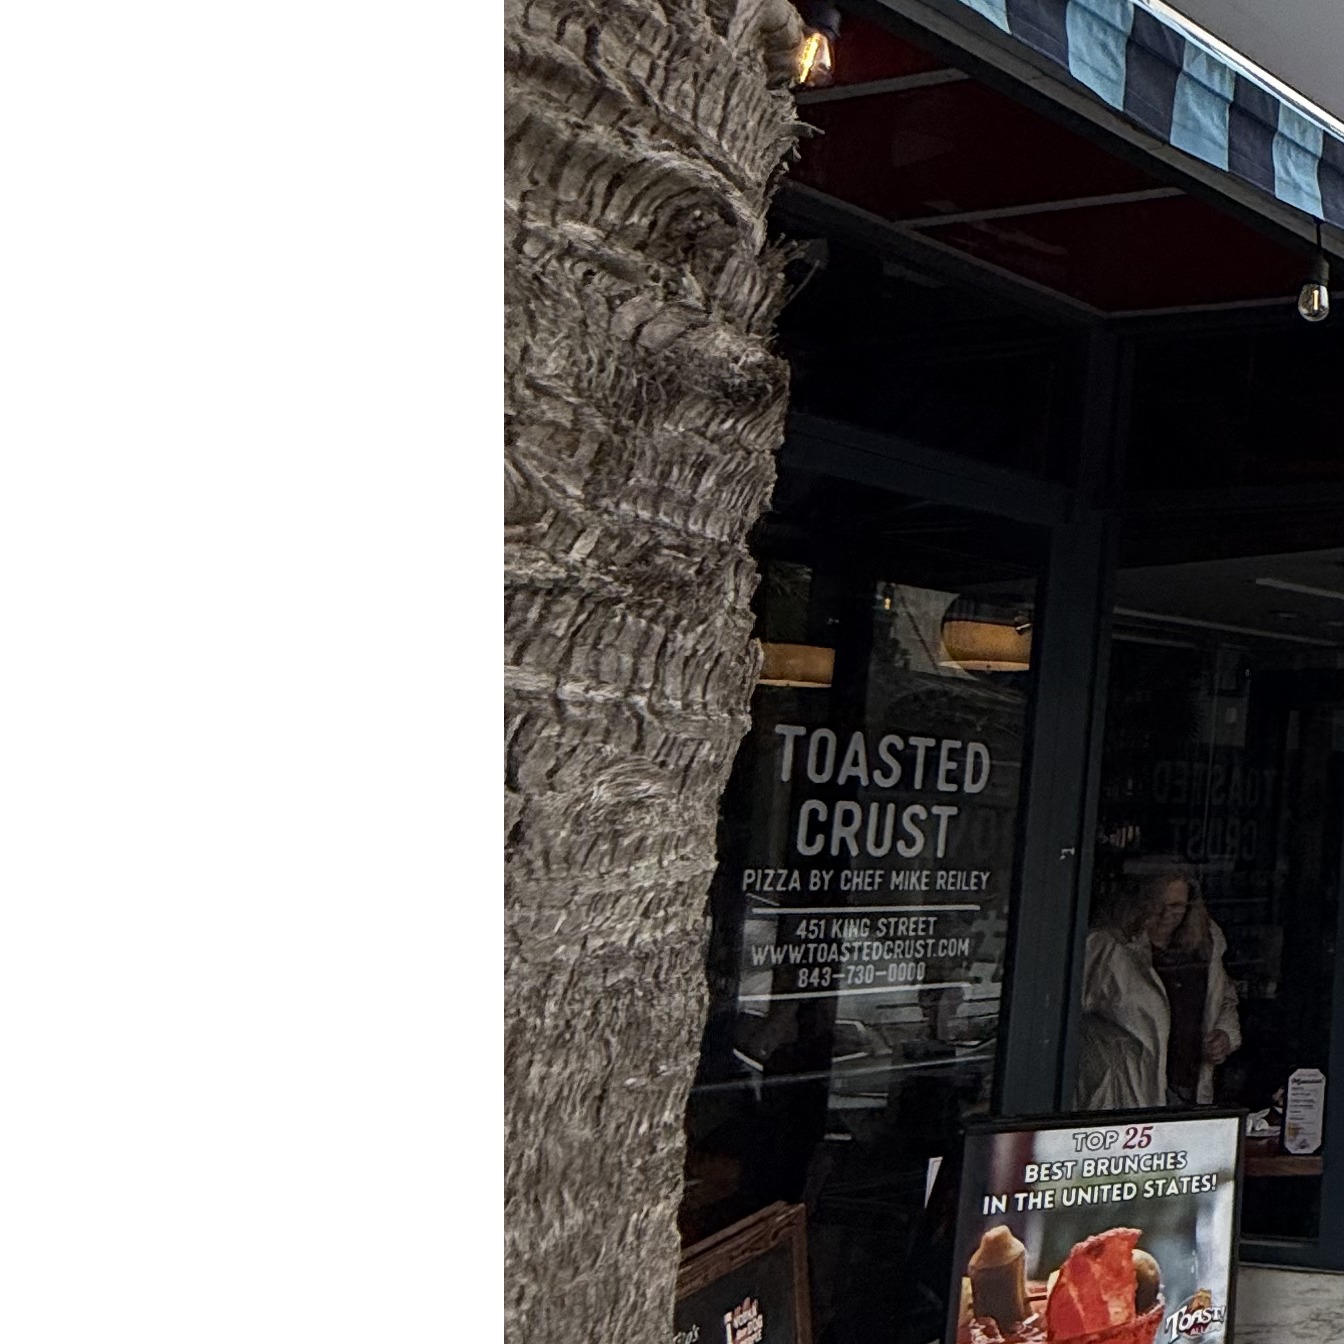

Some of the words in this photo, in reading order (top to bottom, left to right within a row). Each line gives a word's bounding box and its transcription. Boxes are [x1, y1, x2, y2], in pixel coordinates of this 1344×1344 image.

[774, 724, 991, 794] TOASTED
[796, 799, 960, 859] CRUST
[742, 868, 802, 892] PIZZA
[809, 869, 835, 891] BY
[840, 869, 884, 891] CHEF
[890, 870, 930, 891] MIKE
[936, 870, 991, 891] REILEY
[796, 918, 826, 940] 451
[831, 917, 870, 939] KING
[875, 916, 938, 937] STREET
[751, 938, 970, 966] WWW.TOASTEDCRUST.COM
[1073, 1130, 1119, 1153] TOP
[1122, 1125, 1154, 1149] 25
[1024, 1160, 1078, 1184] BEST
[1082, 1151, 1188, 1179] BRUNCHES
[982, 1194, 1008, 1216] IN
[1014, 1191, 1055, 1212] THE
[1062, 1182, 1138, 1207] UNITED
[1142, 1174, 1218, 1199] STATES!
[1164, 1305, 1226, 1344] TOAST!
